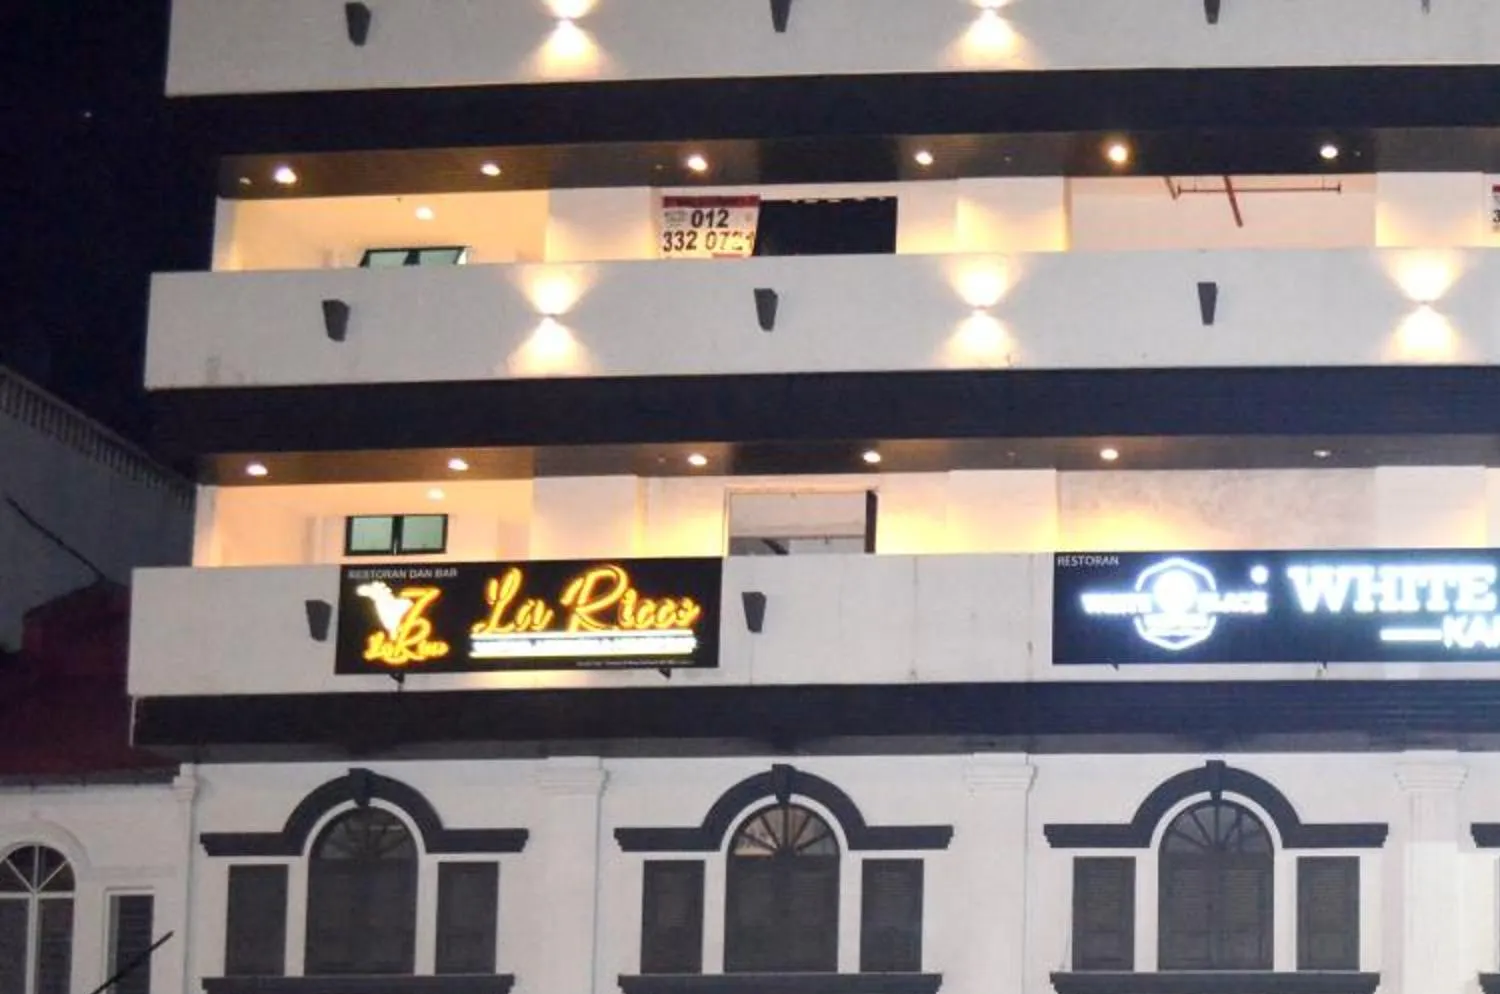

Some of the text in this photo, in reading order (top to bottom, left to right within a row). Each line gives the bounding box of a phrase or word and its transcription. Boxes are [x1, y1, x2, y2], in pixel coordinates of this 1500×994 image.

[691, 209, 729, 228] 012
[663, 230, 698, 252] 332
[1057, 556, 1119, 567] RESTORAN
[348, 567, 458, 579] RESTORAN DAN BAR
[1287, 564, 1497, 612] WHITE
